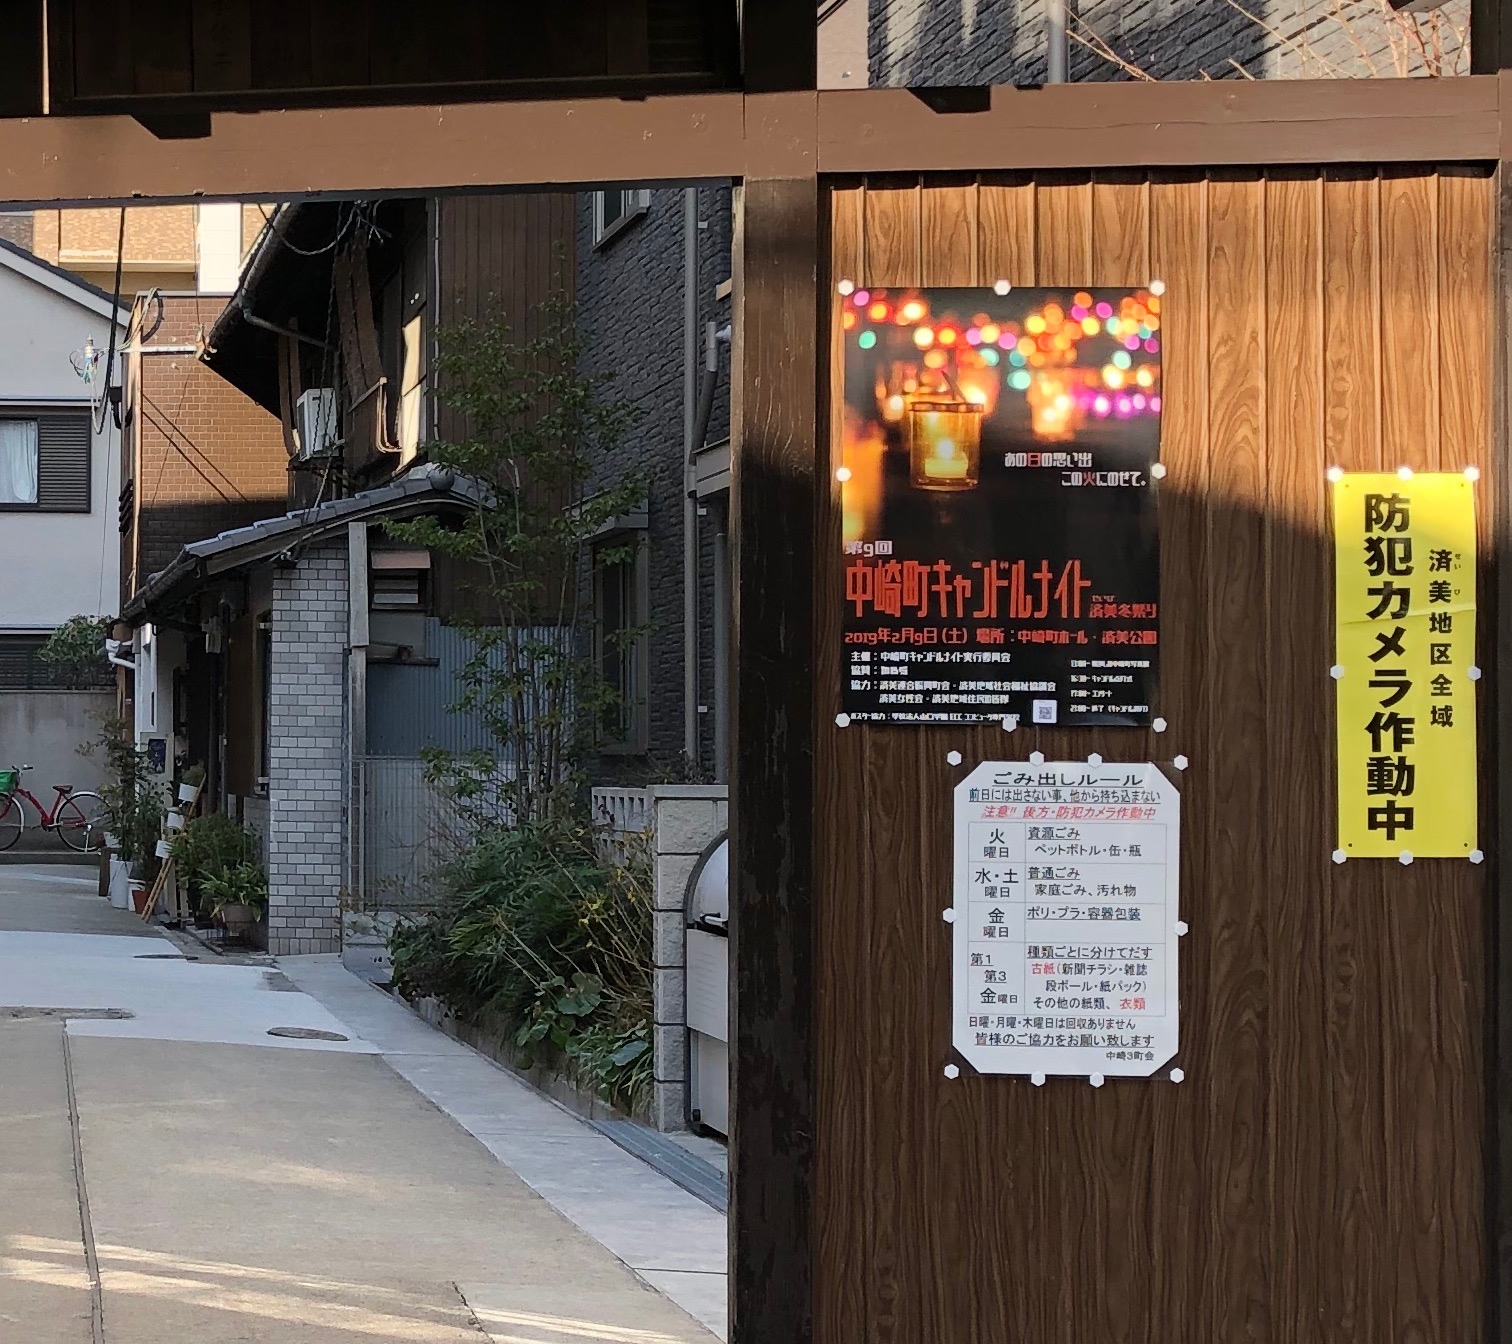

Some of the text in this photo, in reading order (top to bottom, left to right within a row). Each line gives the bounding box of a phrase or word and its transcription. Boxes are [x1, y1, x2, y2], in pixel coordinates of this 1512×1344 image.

[1004, 452, 1093, 468] あの日の思い出
[1061, 471, 1147, 487] この火にのせて。
[844, 540, 893, 557] 第9回
[845, 559, 1092, 618] 中崎町キャンドルナイト
[1428, 549, 1454, 728] 済美地区全域
[1363, 492, 1416, 841] 防犯カメラ作動中
[993, 772, 1143, 786] ごみ出しルール
[989, 828, 1005, 844] 火
[1028, 826, 1081, 840] 資源ごみ
[983, 846, 1009, 858] 曜日
[974, 868, 1019, 884] 水・土
[1028, 866, 1081, 879] 普通ごみ
[984, 886, 1010, 898] 曜日
[1034, 884, 1136, 897] 家庭ごみ、汚れ物
[988, 907, 1005, 924] 金
[983, 926, 1009, 938] 曜日
[970, 952, 992, 965] 第1
[1027, 945, 1153, 959] 種類ごとに分けてだす
[984, 970, 1007, 982] 第3
[1120, 997, 1146, 1010] 衣類
[975, 1032, 1155, 1047] 皆様のご協力をお願い致します
[1106, 1051, 1155, 1061] 中崎3町会
